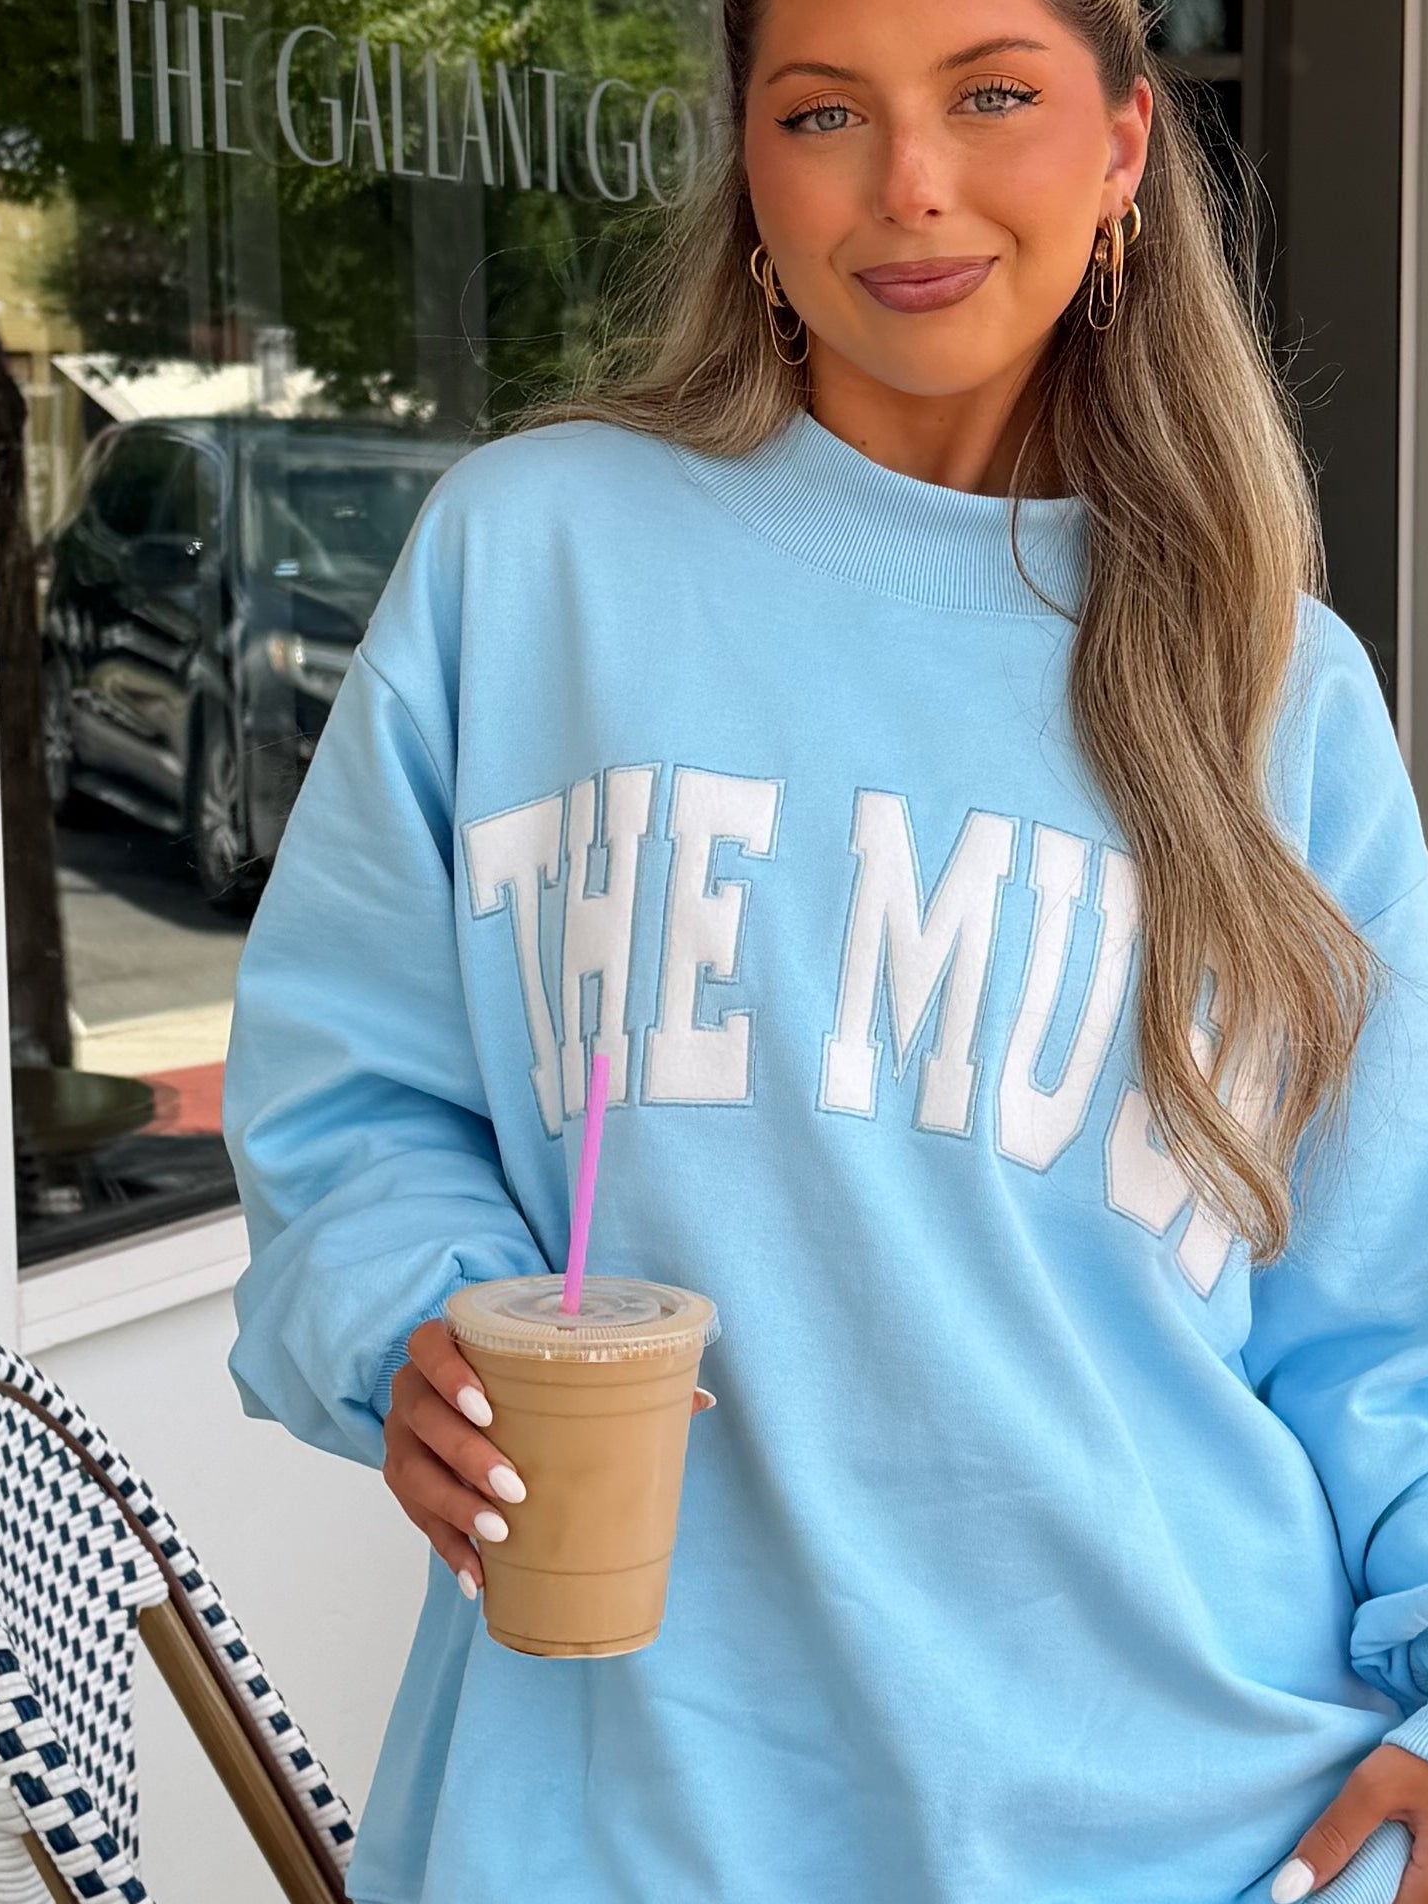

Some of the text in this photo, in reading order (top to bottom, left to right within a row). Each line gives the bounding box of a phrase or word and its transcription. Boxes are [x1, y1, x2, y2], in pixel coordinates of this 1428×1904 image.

[276, 25, 567, 193] GALLANT
[585, 78, 699, 209] GO
[460, 759, 1277, 1300] THE MU
